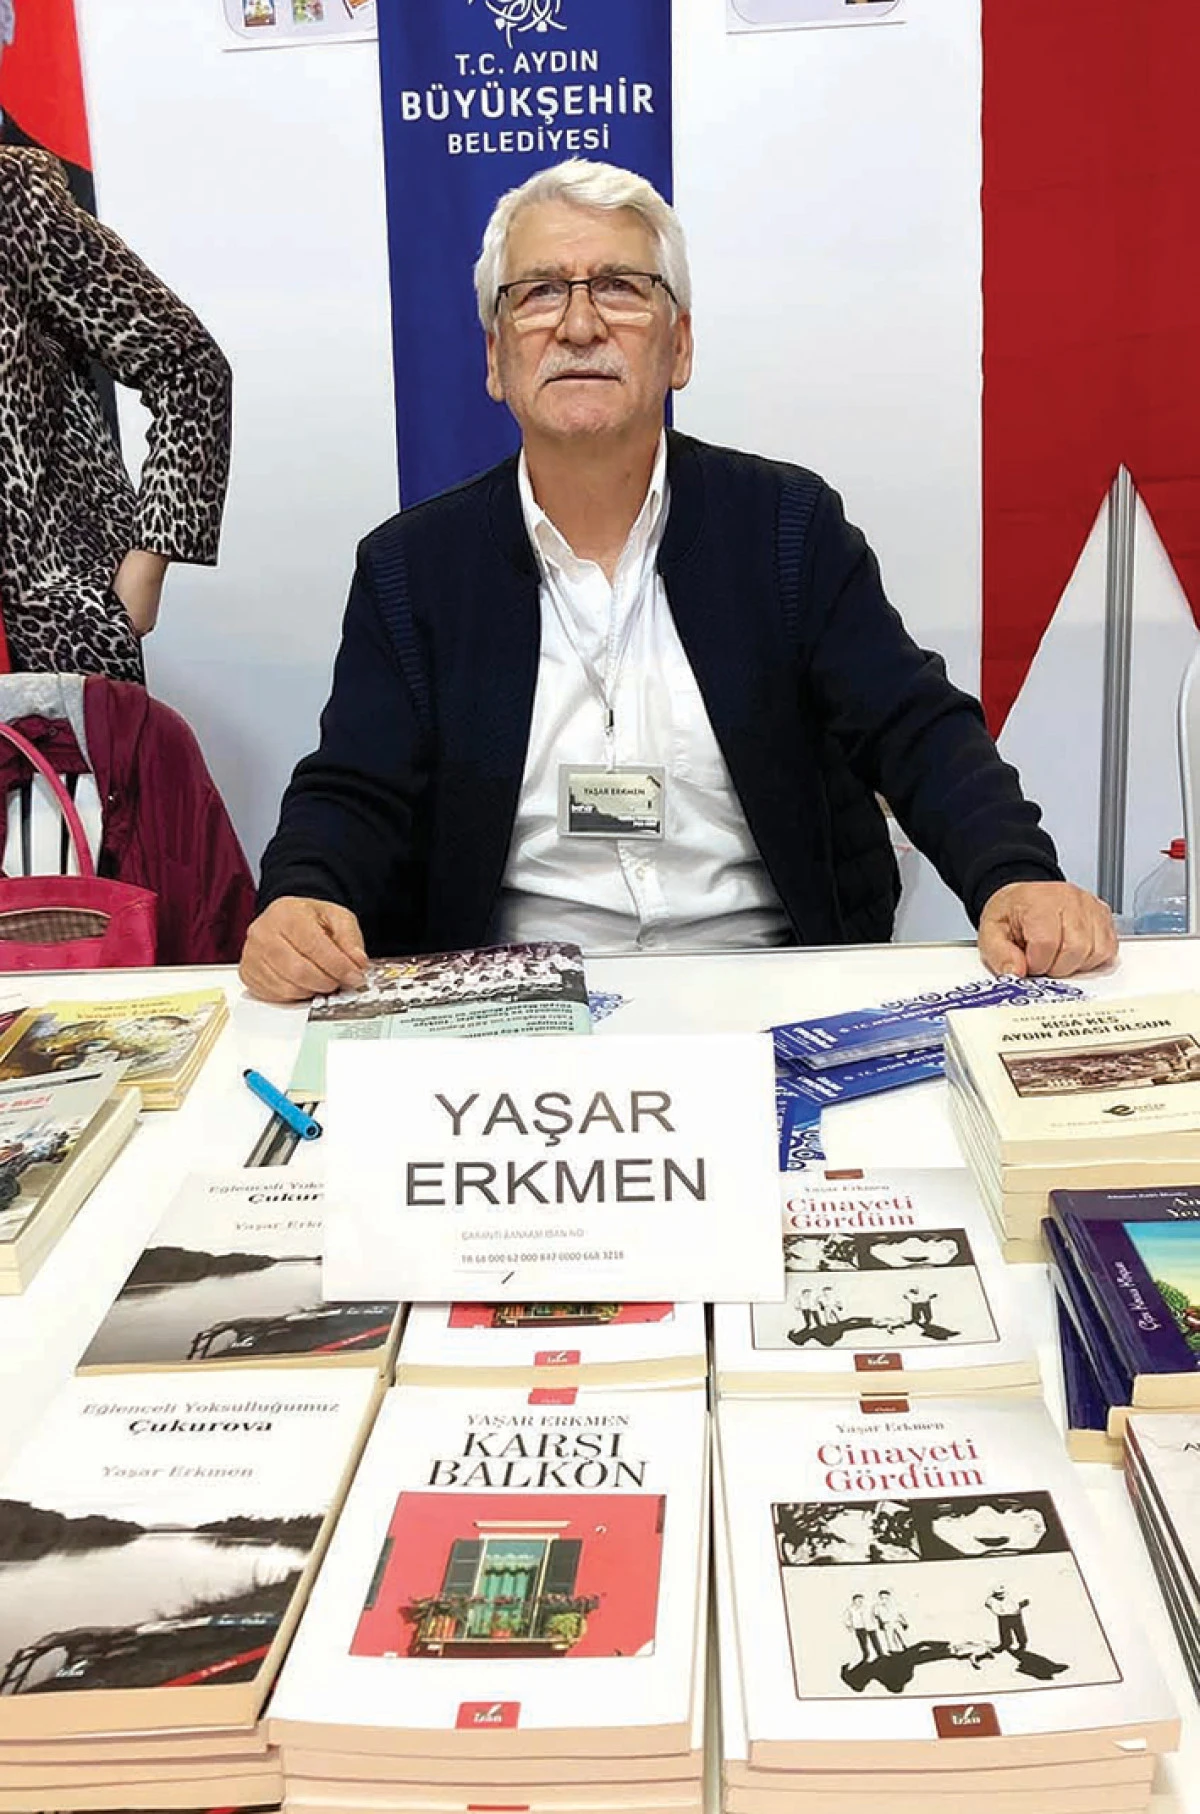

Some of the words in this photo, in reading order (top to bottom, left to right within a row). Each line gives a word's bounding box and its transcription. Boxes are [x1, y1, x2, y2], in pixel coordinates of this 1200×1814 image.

[455, 54, 504, 76] T.C.
[513, 49, 599, 74] AYDIN
[401, 77, 655, 125] BÜYÜKŞEHİR
[448, 123, 610, 155] BELEDİYESİ
[1001, 1031, 1053, 1042] AYDIN
[1113, 1019, 1172, 1032] OLSUN
[1041, 1019, 1083, 1029] KISA
[1085, 1015, 1120, 1026] KES
[435, 1091, 675, 1147] YAŞAR
[405, 1157, 706, 1207] ERKMEN
[786, 1195, 913, 1212] Cinayeti
[790, 1211, 915, 1228] Gördüm
[82, 1402, 177, 1416] Eğlenceli
[184, 1400, 341, 1415] Yoksulluğumuz
[128, 1419, 273, 1436] Çukurova
[467, 1414, 535, 1429] YAŞAR
[540, 1414, 631, 1427] ERKMEN
[835, 1423, 882, 1435] Yaşar
[884, 1421, 945, 1432] Erkmen
[817, 1438, 980, 1467] Cinayeti
[102, 1465, 164, 1479] Yaşar
[168, 1465, 255, 1478] Erkmen
[427, 1460, 650, 1488] BALKON
[825, 1463, 986, 1492] Gördüm
